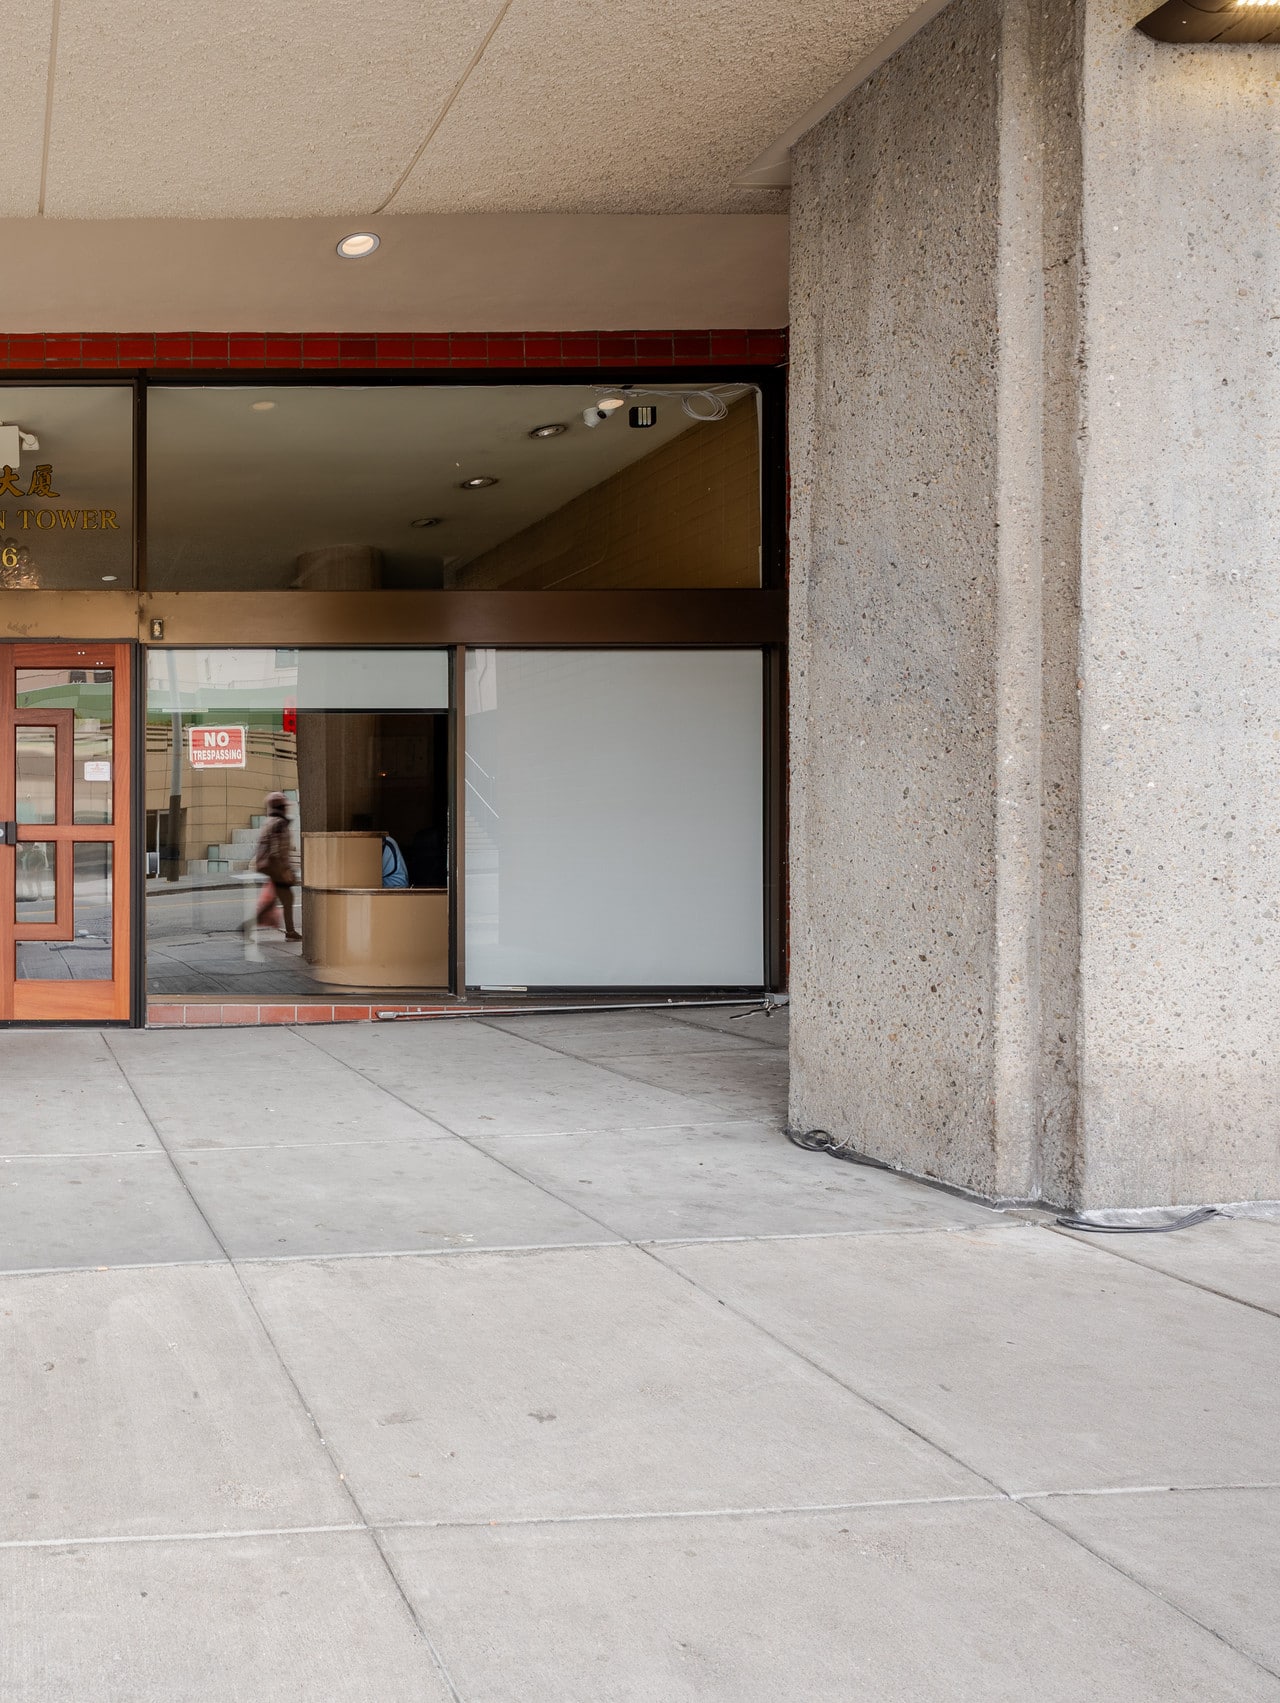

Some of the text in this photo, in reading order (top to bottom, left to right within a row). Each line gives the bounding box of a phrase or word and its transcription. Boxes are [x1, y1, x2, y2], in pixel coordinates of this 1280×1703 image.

[16, 509, 121, 531] TOWER
[203, 731, 230, 747] NO
[192, 748, 242, 761] TRESPASSING
